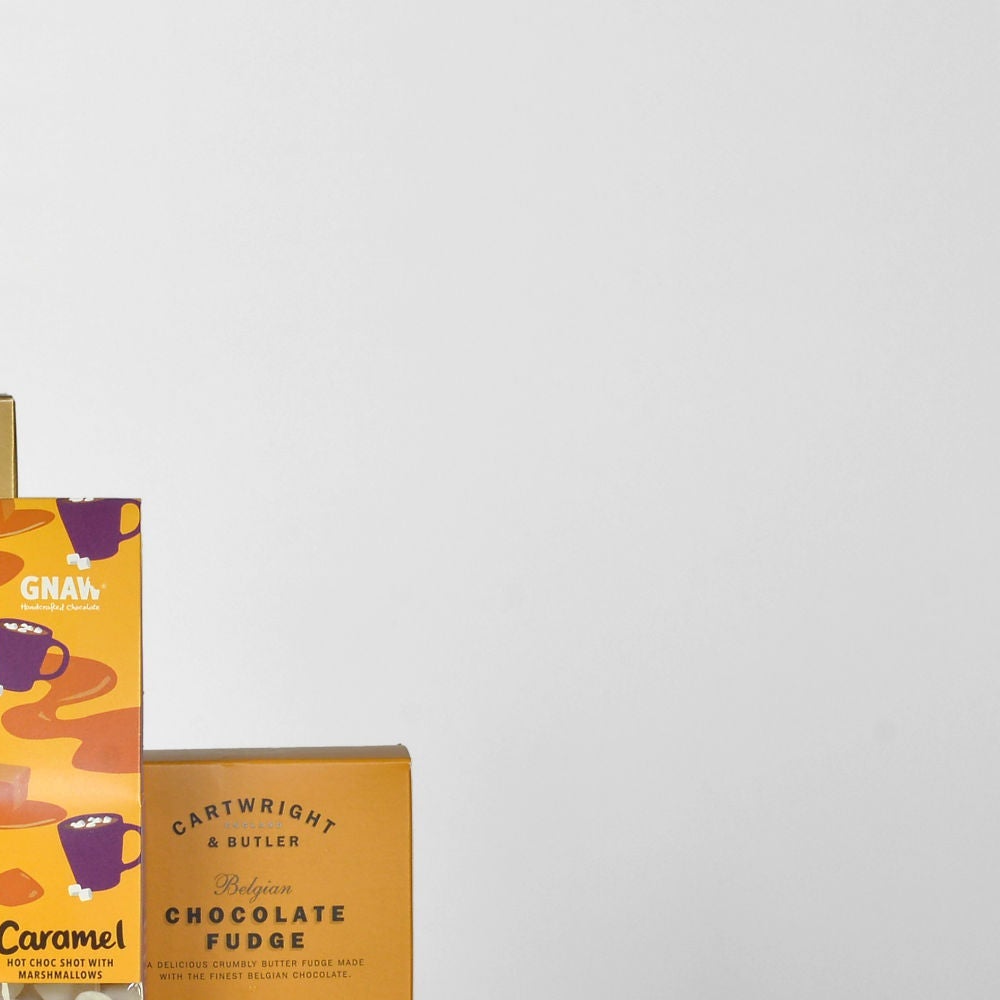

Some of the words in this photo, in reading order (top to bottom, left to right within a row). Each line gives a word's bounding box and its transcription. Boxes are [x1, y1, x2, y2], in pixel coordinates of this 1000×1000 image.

[20, 575, 101, 601] GNAW
[172, 797, 336, 836] CARTWRIGHT
[207, 837, 219, 848] &
[228, 835, 300, 847] BUTLER
[213, 873, 293, 904] Belgian
[165, 905, 345, 924] CHOCOLATE
[207, 932, 305, 950] FUDGE
[7, 958, 27, 967] HOT
[29, 958, 56, 967] CHOC
[60, 958, 85, 967] SHOT
[88, 958, 114, 967] WITH
[157, 961, 208, 969] DELICIOUS
[213, 960, 257, 968] CRUMBLY
[302, 959, 333, 967] FUDGE
[18, 970, 103, 980] MARSHMALLOWS
[210, 972, 243, 980] FINEST
[248, 972, 288, 980] BELGIAN
